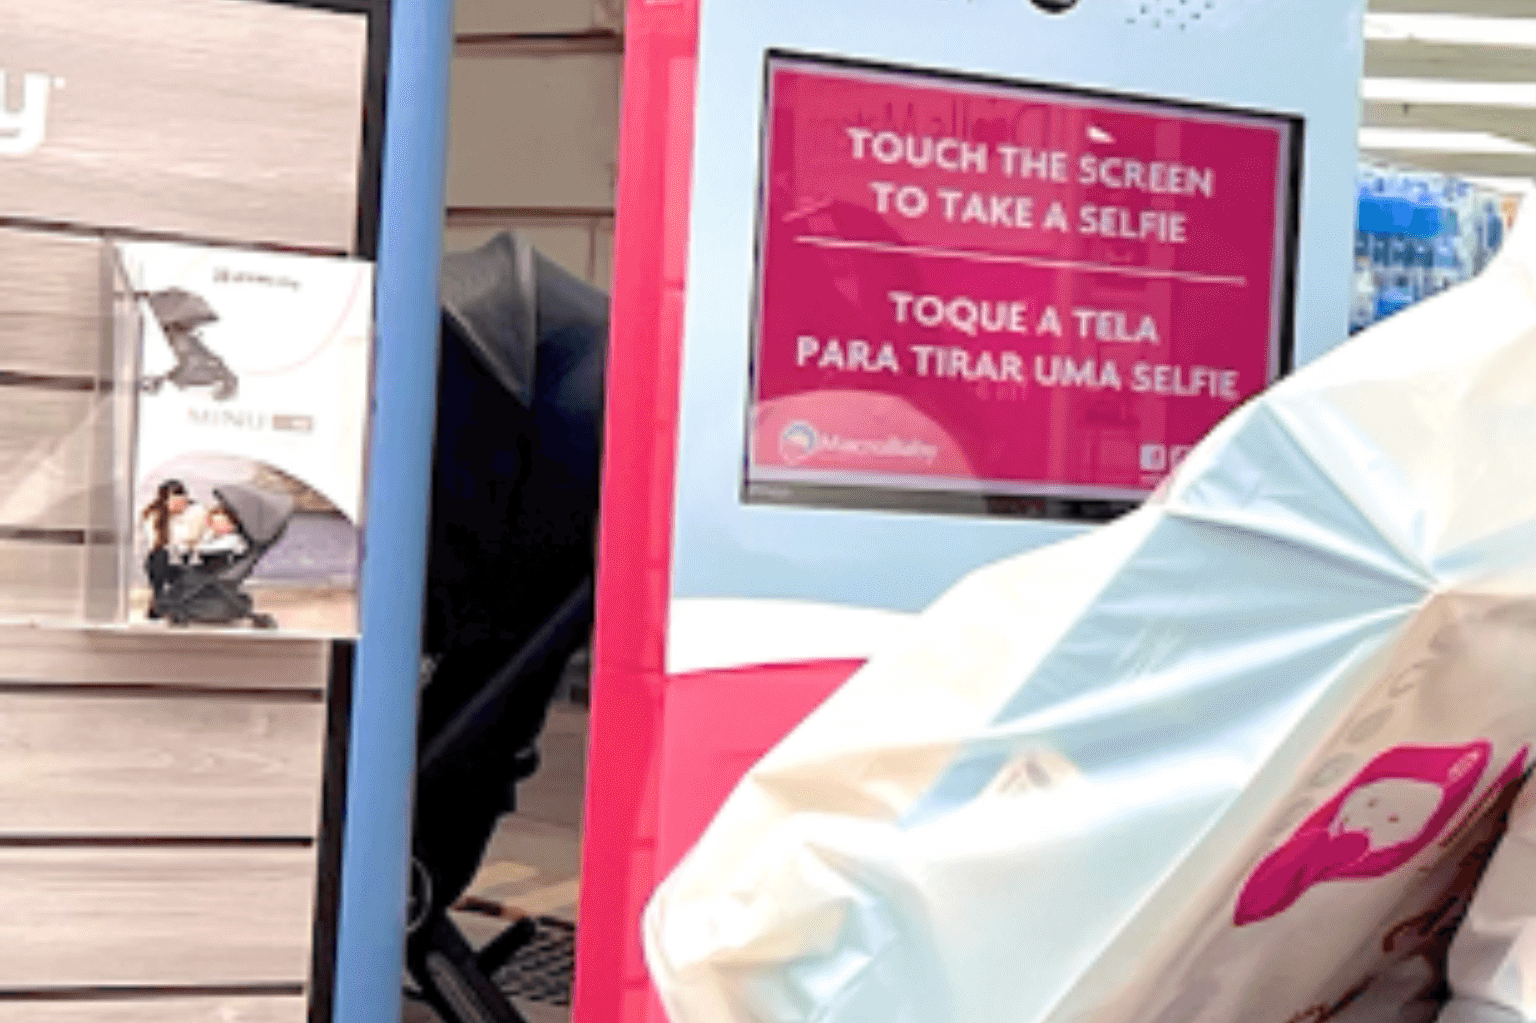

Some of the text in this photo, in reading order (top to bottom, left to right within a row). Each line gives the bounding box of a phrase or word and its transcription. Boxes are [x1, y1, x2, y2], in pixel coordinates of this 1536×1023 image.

[847, 126, 1213, 199] TOUCH THE SCREEN
[870, 180, 1188, 244] TO TAKE A SELFIE
[889, 290, 1160, 346] TOQUE A TELA
[796, 335, 1240, 400] PARA TIRAR UMA SELFIE
